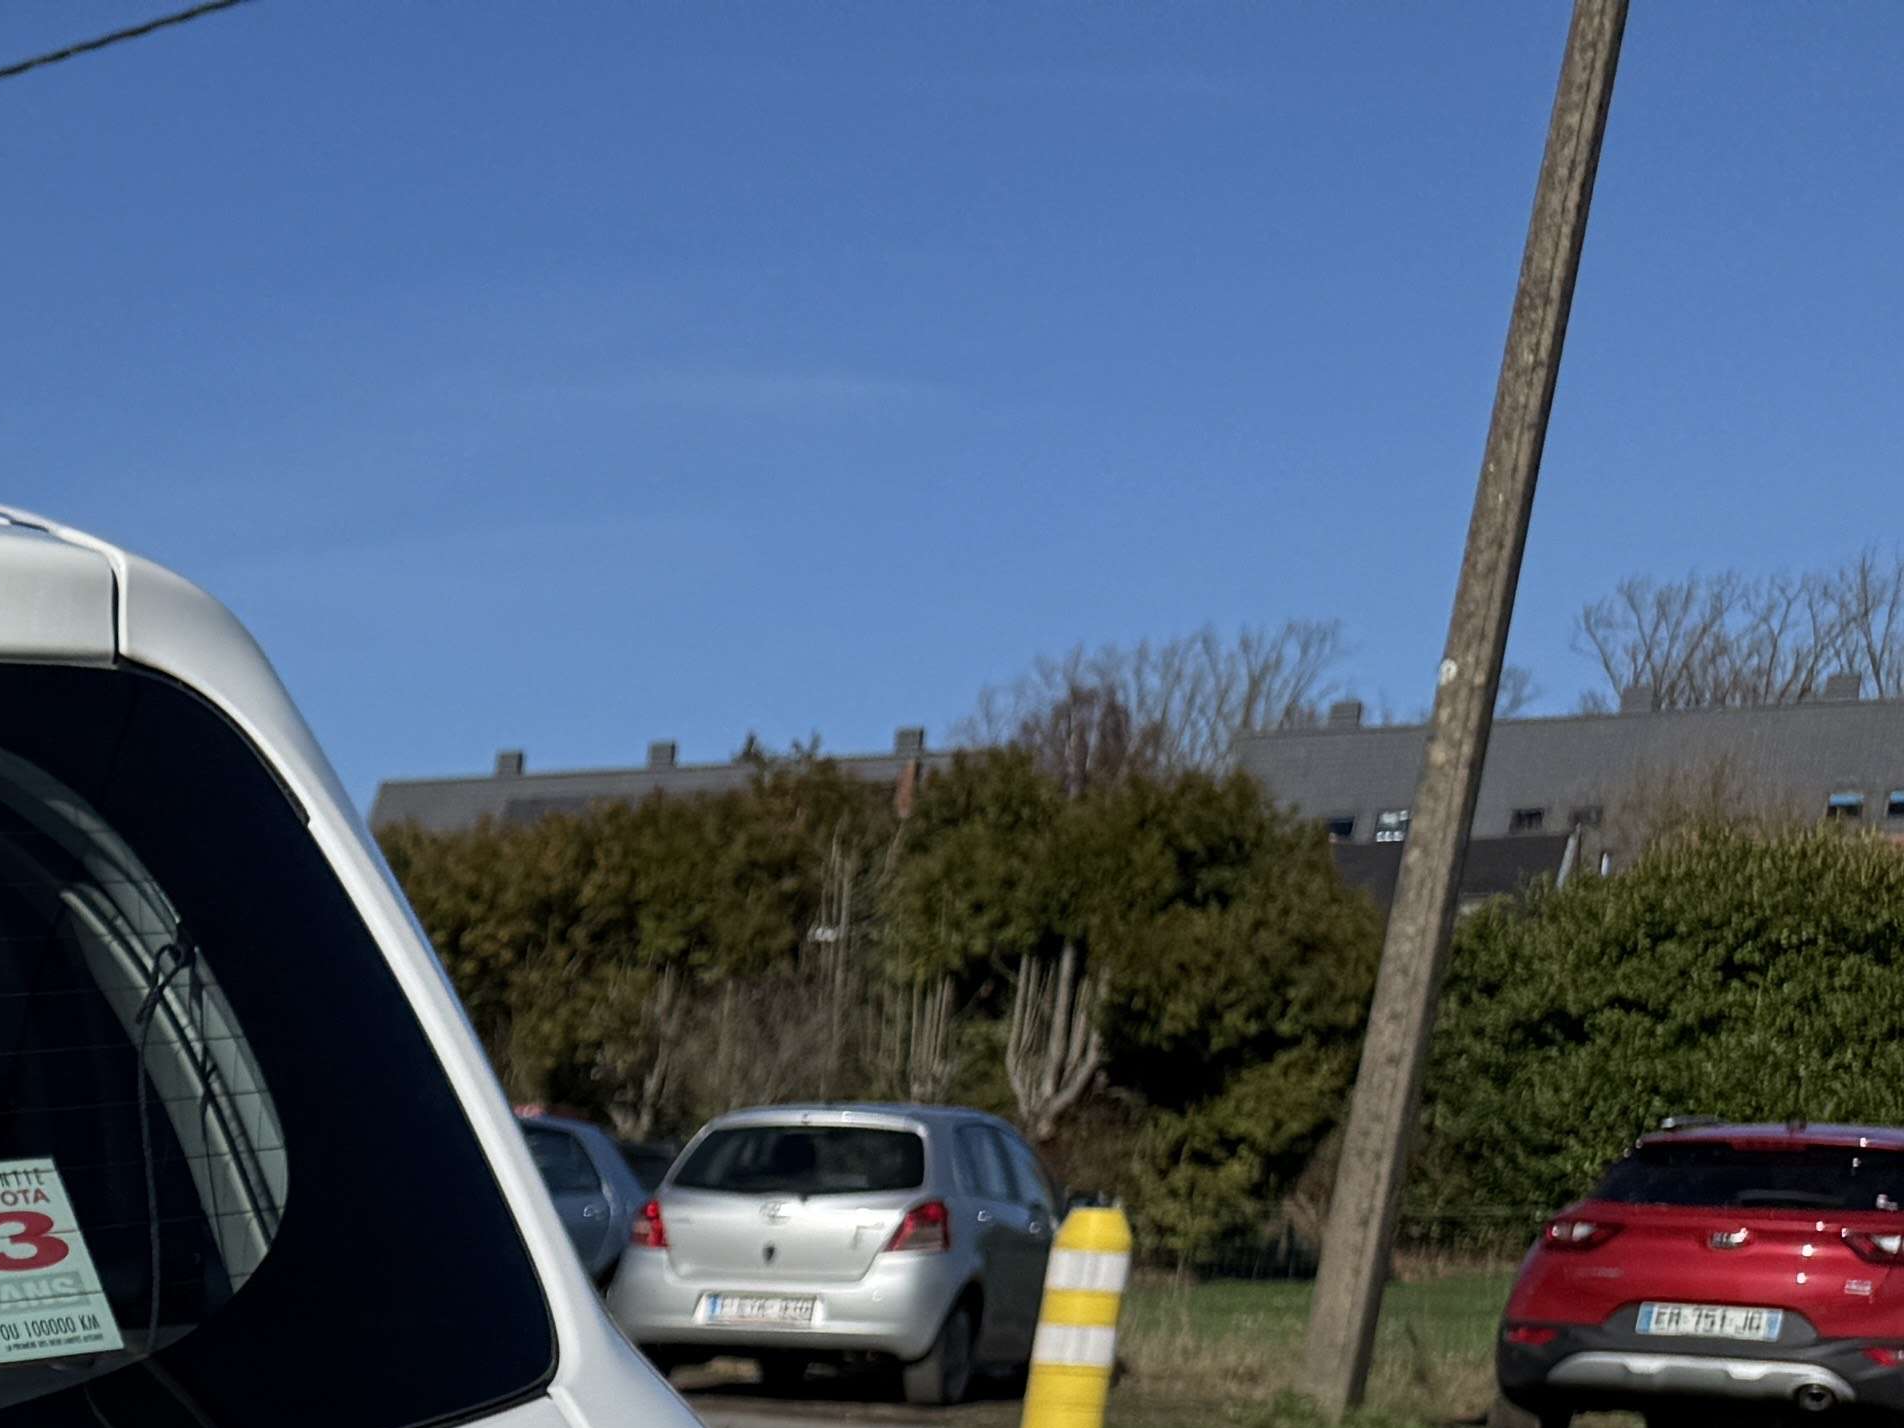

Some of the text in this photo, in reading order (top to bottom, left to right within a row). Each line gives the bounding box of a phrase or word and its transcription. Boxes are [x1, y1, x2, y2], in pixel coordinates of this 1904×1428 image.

[0, 1276, 80, 1311] ANS
[0, 1322, 20, 1342] OU
[23, 1316, 77, 1339] 100000
[79, 1313, 101, 1332] KM
